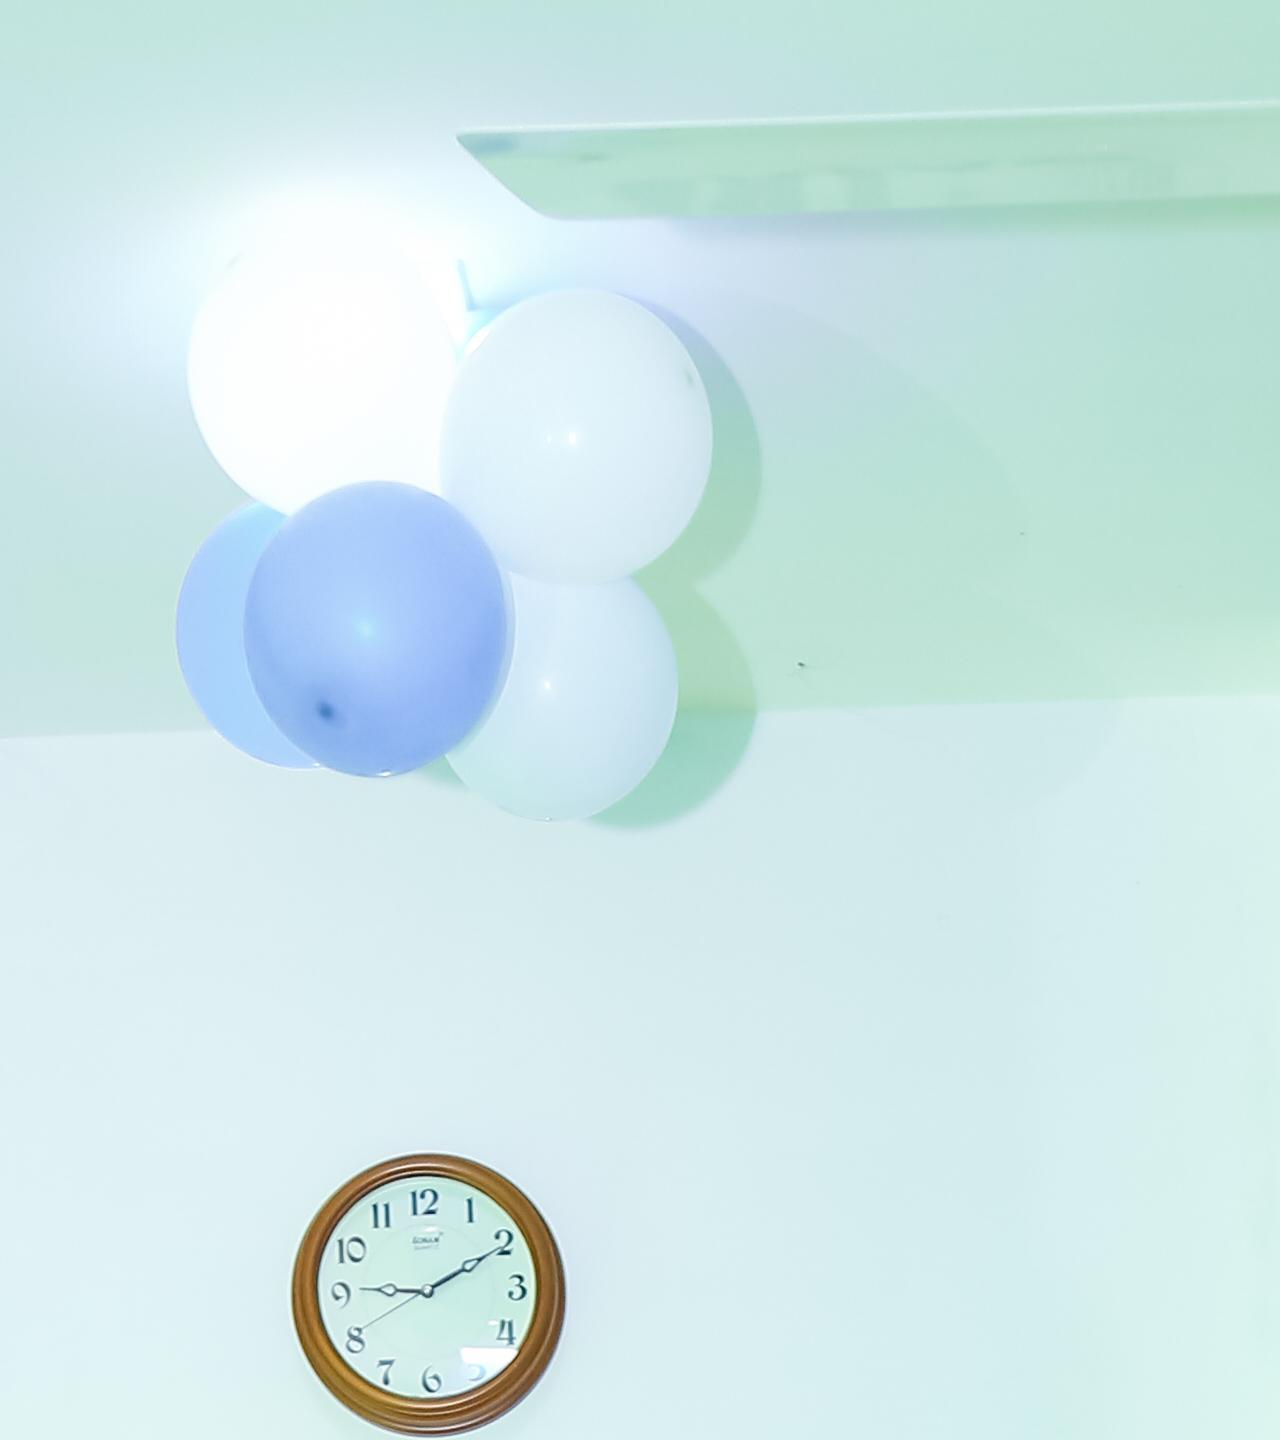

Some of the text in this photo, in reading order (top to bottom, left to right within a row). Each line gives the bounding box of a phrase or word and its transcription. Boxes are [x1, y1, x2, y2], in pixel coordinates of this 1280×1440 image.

[371, 1202, 391, 1229] 11
[410, 1188, 439, 1216] 12
[465, 1197, 475, 1224] 1
[337, 1236, 366, 1264] 10
[494, 1229, 513, 1256] 2
[331, 1281, 351, 1309] 9
[507, 1274, 528, 1301] 3
[345, 1325, 365, 1354] 8
[496, 1319, 517, 1345] 4
[377, 1359, 395, 1386] 7
[421, 1365, 442, 1393] 6
